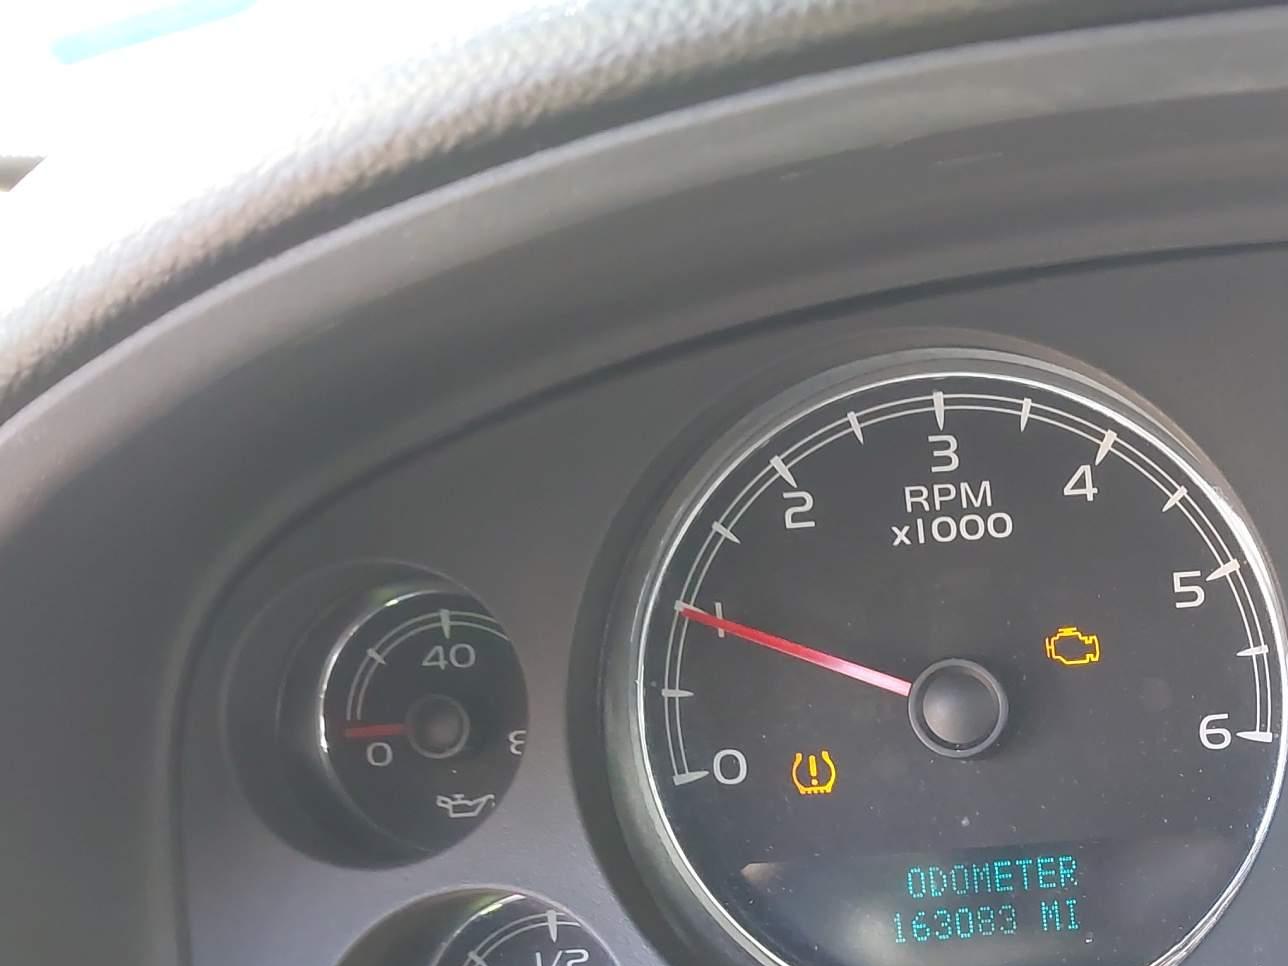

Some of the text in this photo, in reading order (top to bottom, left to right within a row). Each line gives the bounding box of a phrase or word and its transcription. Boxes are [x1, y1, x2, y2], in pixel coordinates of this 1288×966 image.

[929, 435, 960, 472] 3
[904, 480, 993, 514] RPM
[1062, 465, 1099, 502] 4
[783, 490, 816, 528] 2
[891, 512, 1013, 547] x1000
[1172, 570, 1204, 608] 5
[421, 644, 475, 671] 40
[1199, 713, 1231, 750] 6
[366, 742, 392, 767] 0
[713, 749, 747, 785] 0
[907, 856, 1077, 899] ODOMETER
[893, 900, 1078, 945] 163083 MI
